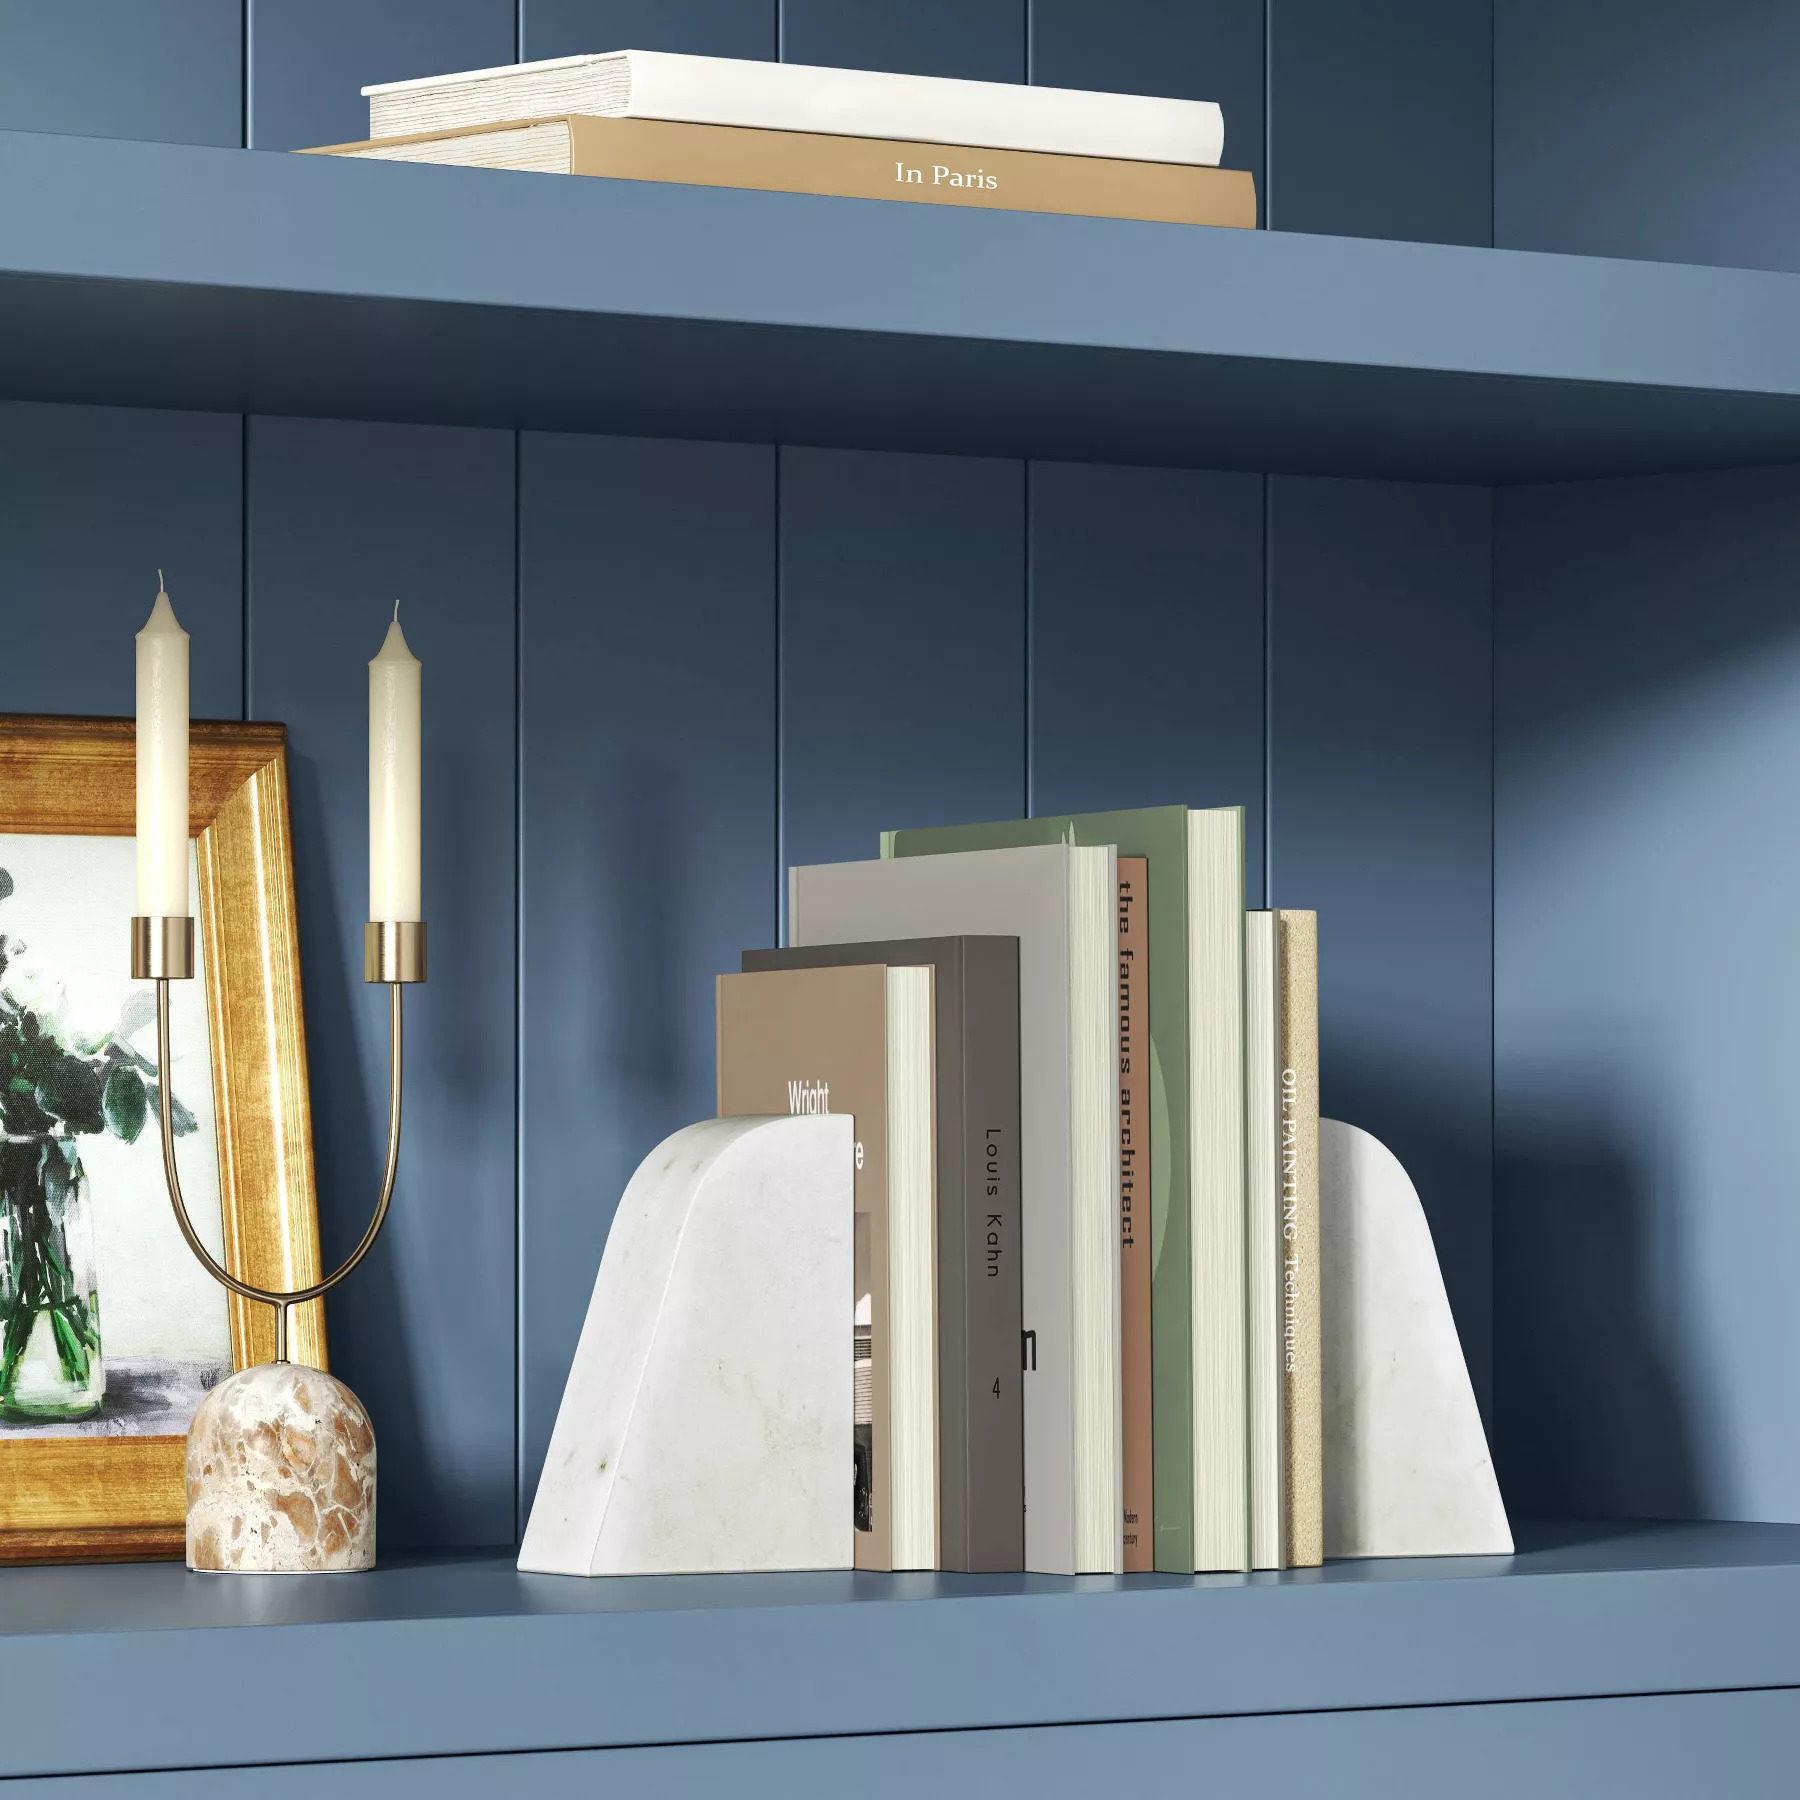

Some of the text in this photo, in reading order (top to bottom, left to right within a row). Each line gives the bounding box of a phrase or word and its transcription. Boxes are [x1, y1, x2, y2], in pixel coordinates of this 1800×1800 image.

[895, 161, 998, 190] In Paris
[1119, 880, 1136, 1249] the famous architect
[986, 1128, 1003, 1277] Louis Kahn
[1281, 1068, 1300, 1373] OIL PAINTING Techniques
[992, 1376, 1001, 1400] 4
